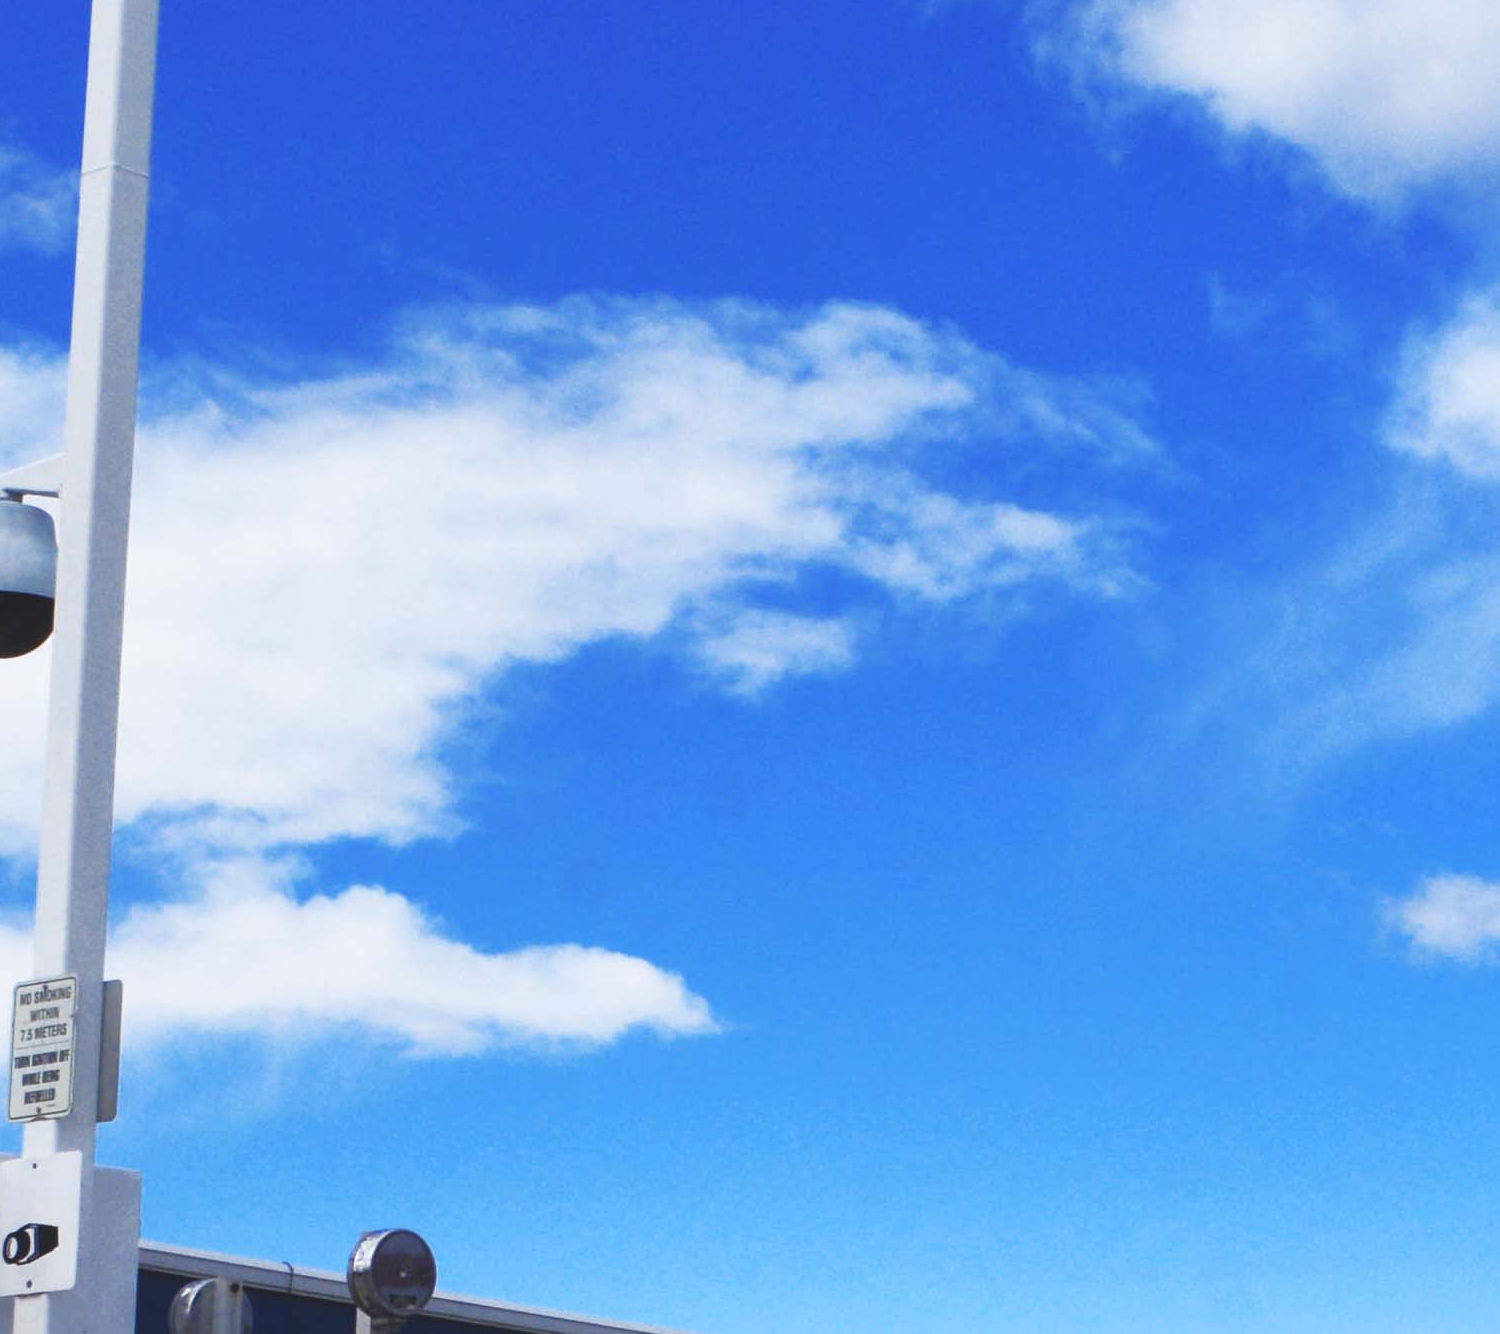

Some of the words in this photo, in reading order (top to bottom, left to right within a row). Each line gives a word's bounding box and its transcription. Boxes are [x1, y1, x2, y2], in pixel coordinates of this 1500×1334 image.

[20, 992, 32, 1005] NO
[34, 987, 72, 1004] SMOKING
[30, 1007, 60, 1022] WITHIN
[20, 1030, 33, 1042] 7.5
[35, 1024, 67, 1040] METERS
